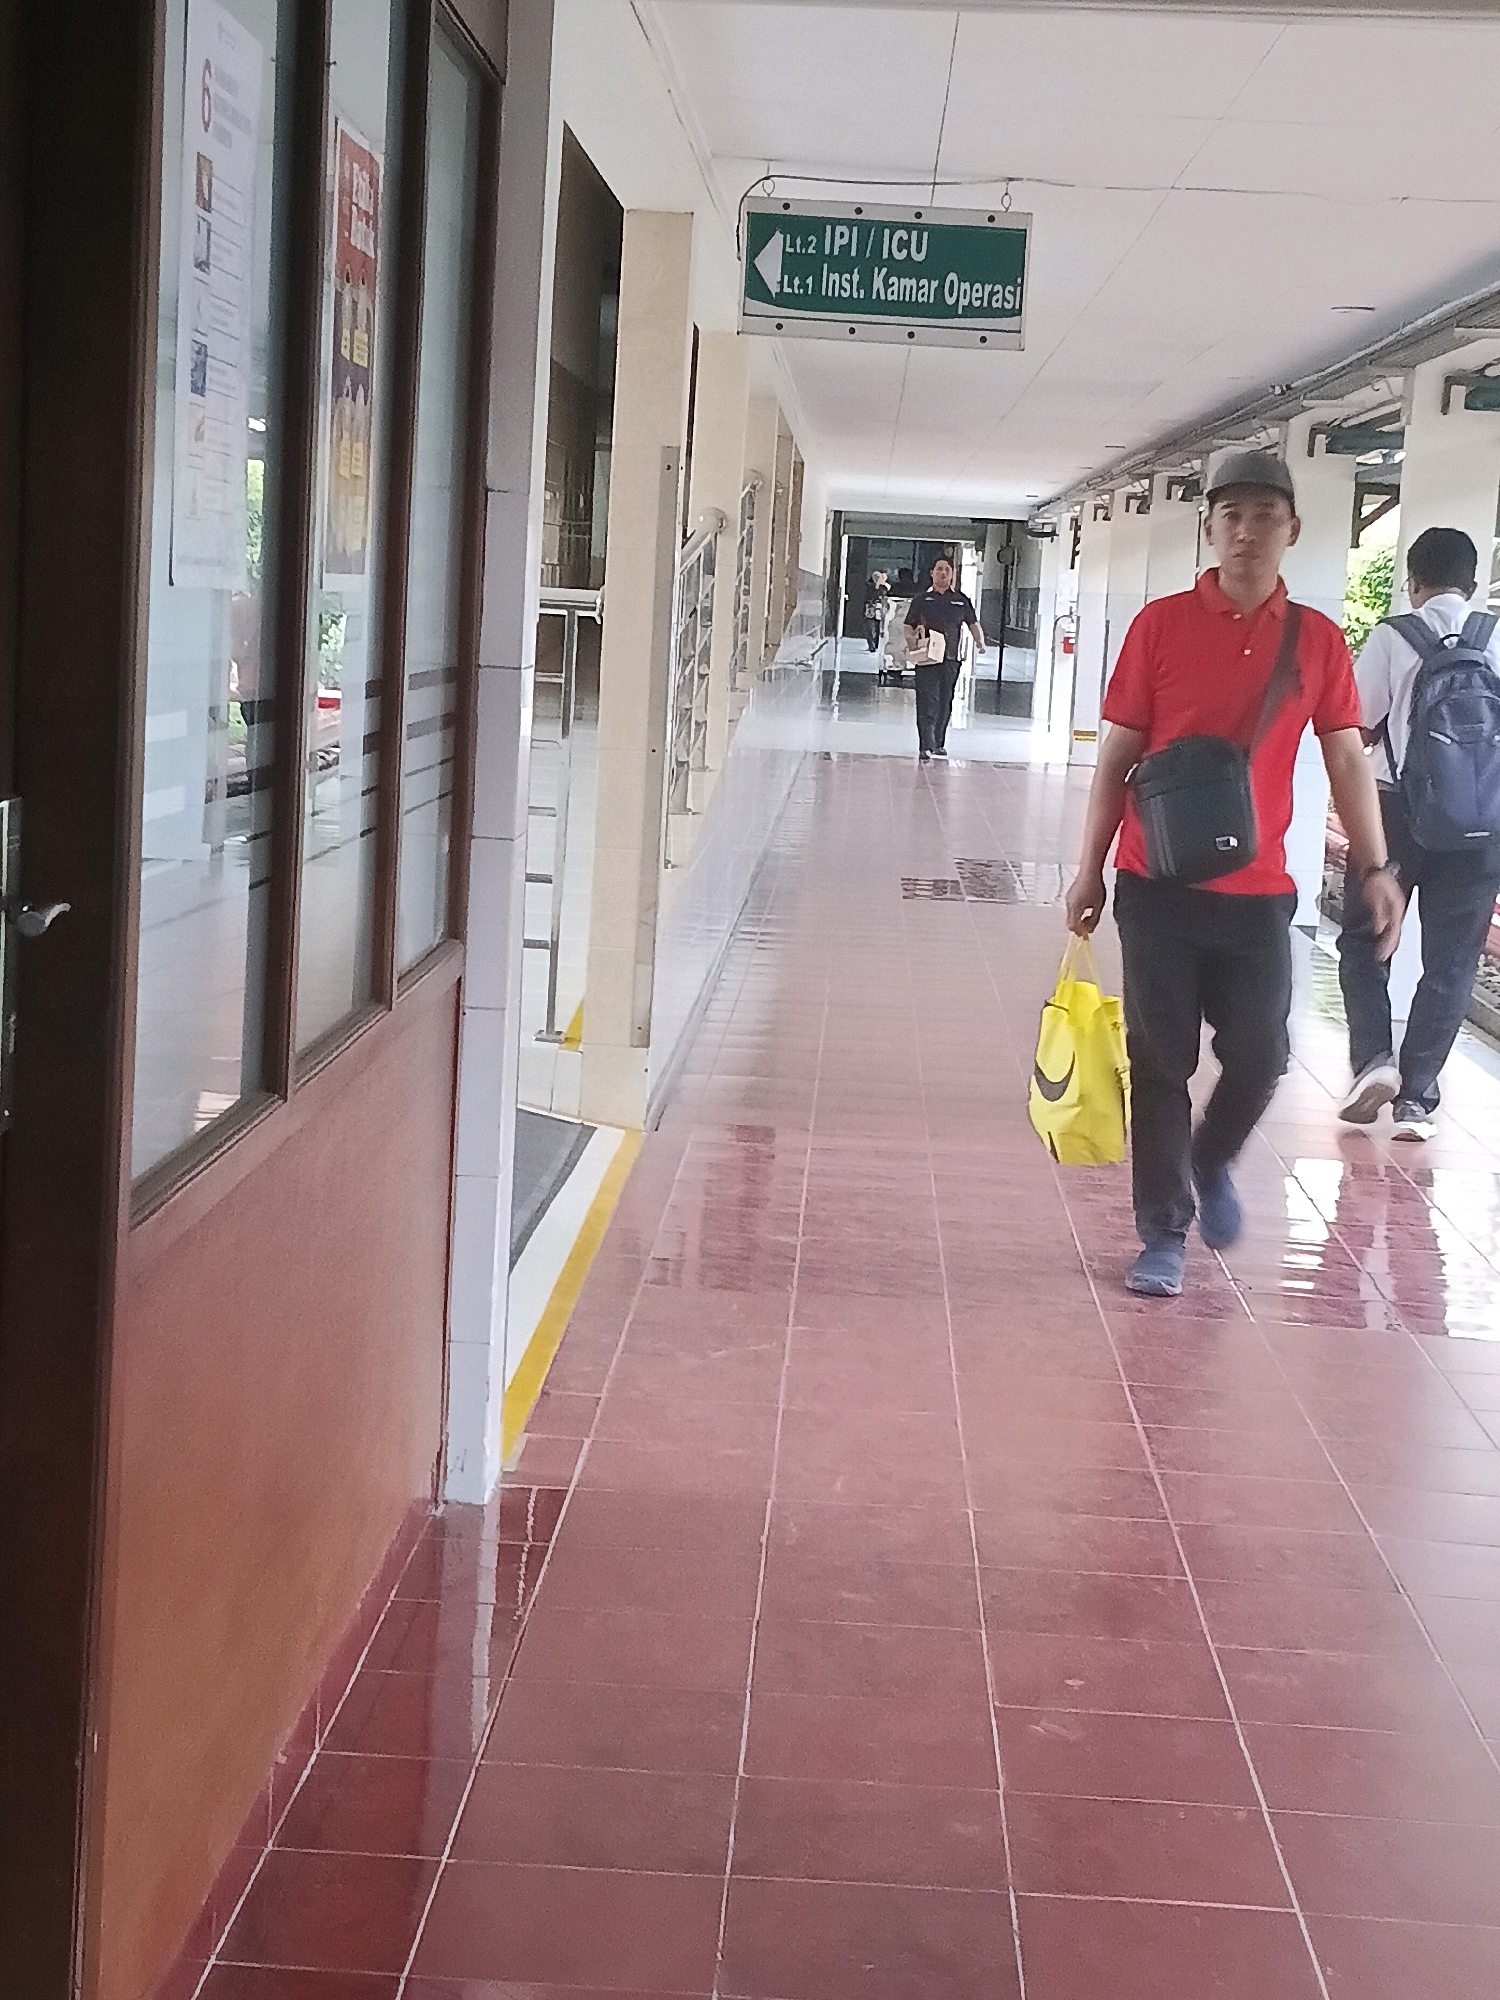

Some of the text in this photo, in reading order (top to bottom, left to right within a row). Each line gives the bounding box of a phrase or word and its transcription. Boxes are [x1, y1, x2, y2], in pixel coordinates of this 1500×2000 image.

[201, 58, 212, 133] 6
[786, 225, 929, 262] Lt.2 IPI / ICU
[783, 262, 1021, 315] Lt.1 Inst. Kamar Operasi
